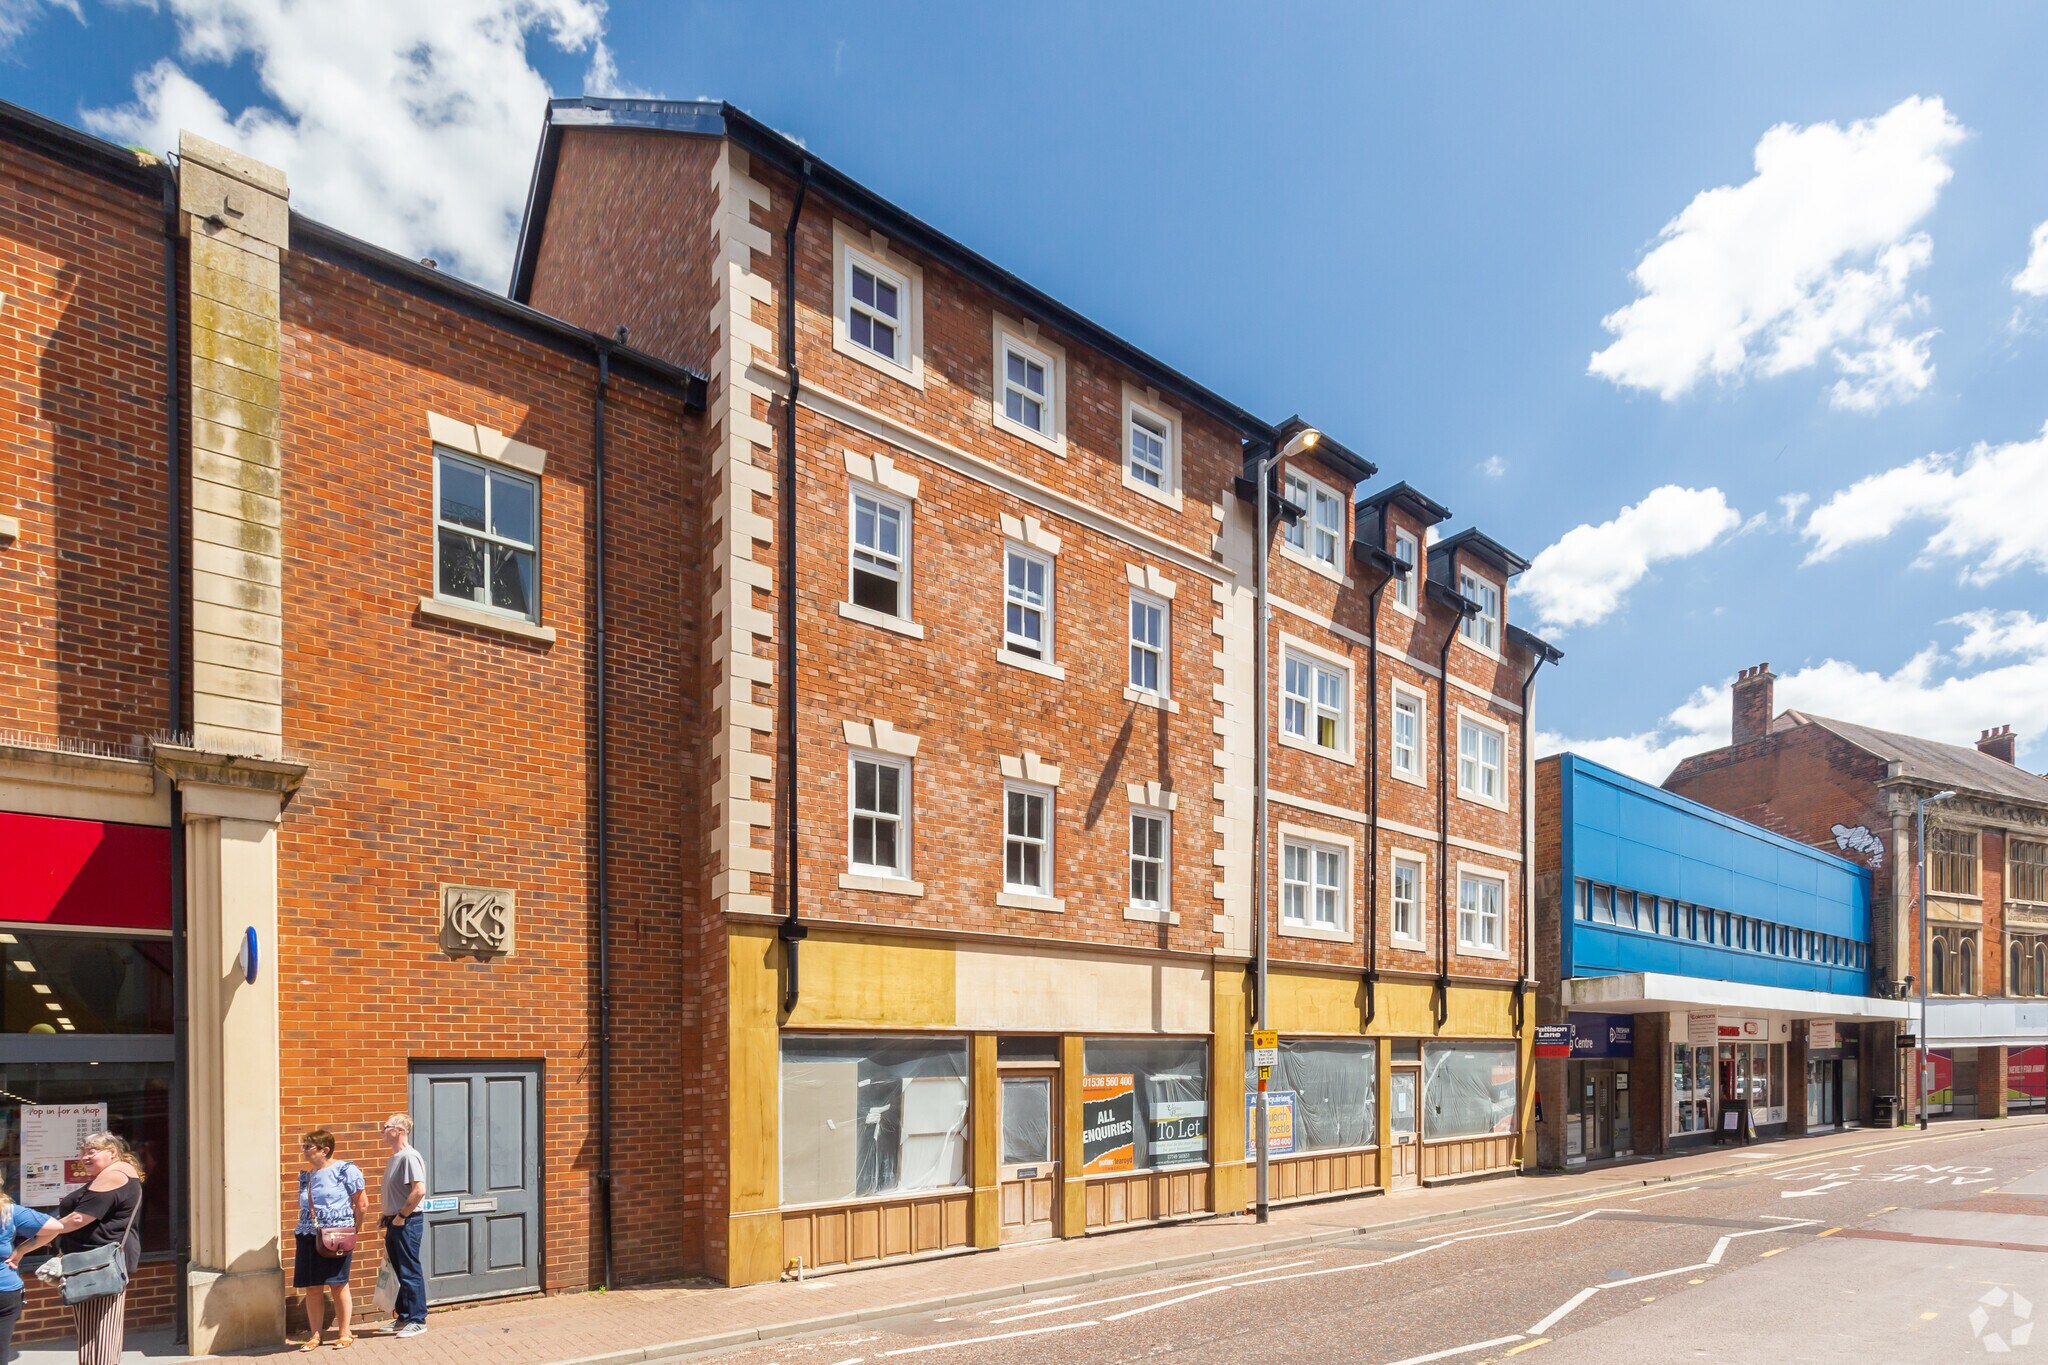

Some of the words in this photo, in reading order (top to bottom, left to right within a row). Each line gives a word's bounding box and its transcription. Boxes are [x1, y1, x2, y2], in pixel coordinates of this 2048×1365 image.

[1575, 1037, 1593, 1049] Centre
[1083, 1077, 1105, 1087] 01536
[1119, 1076, 1133, 1086] 400
[1269, 1095, 1291, 1104] quiries
[58, 1106, 70, 1117] for
[82, 1106, 100, 1116] shop
[1097, 1109, 1115, 1124] ALL
[1083, 1120, 1132, 1143] ENQUIRIES
[1157, 1121, 1174, 1140] To
[1178, 1119, 1201, 1138] Let
